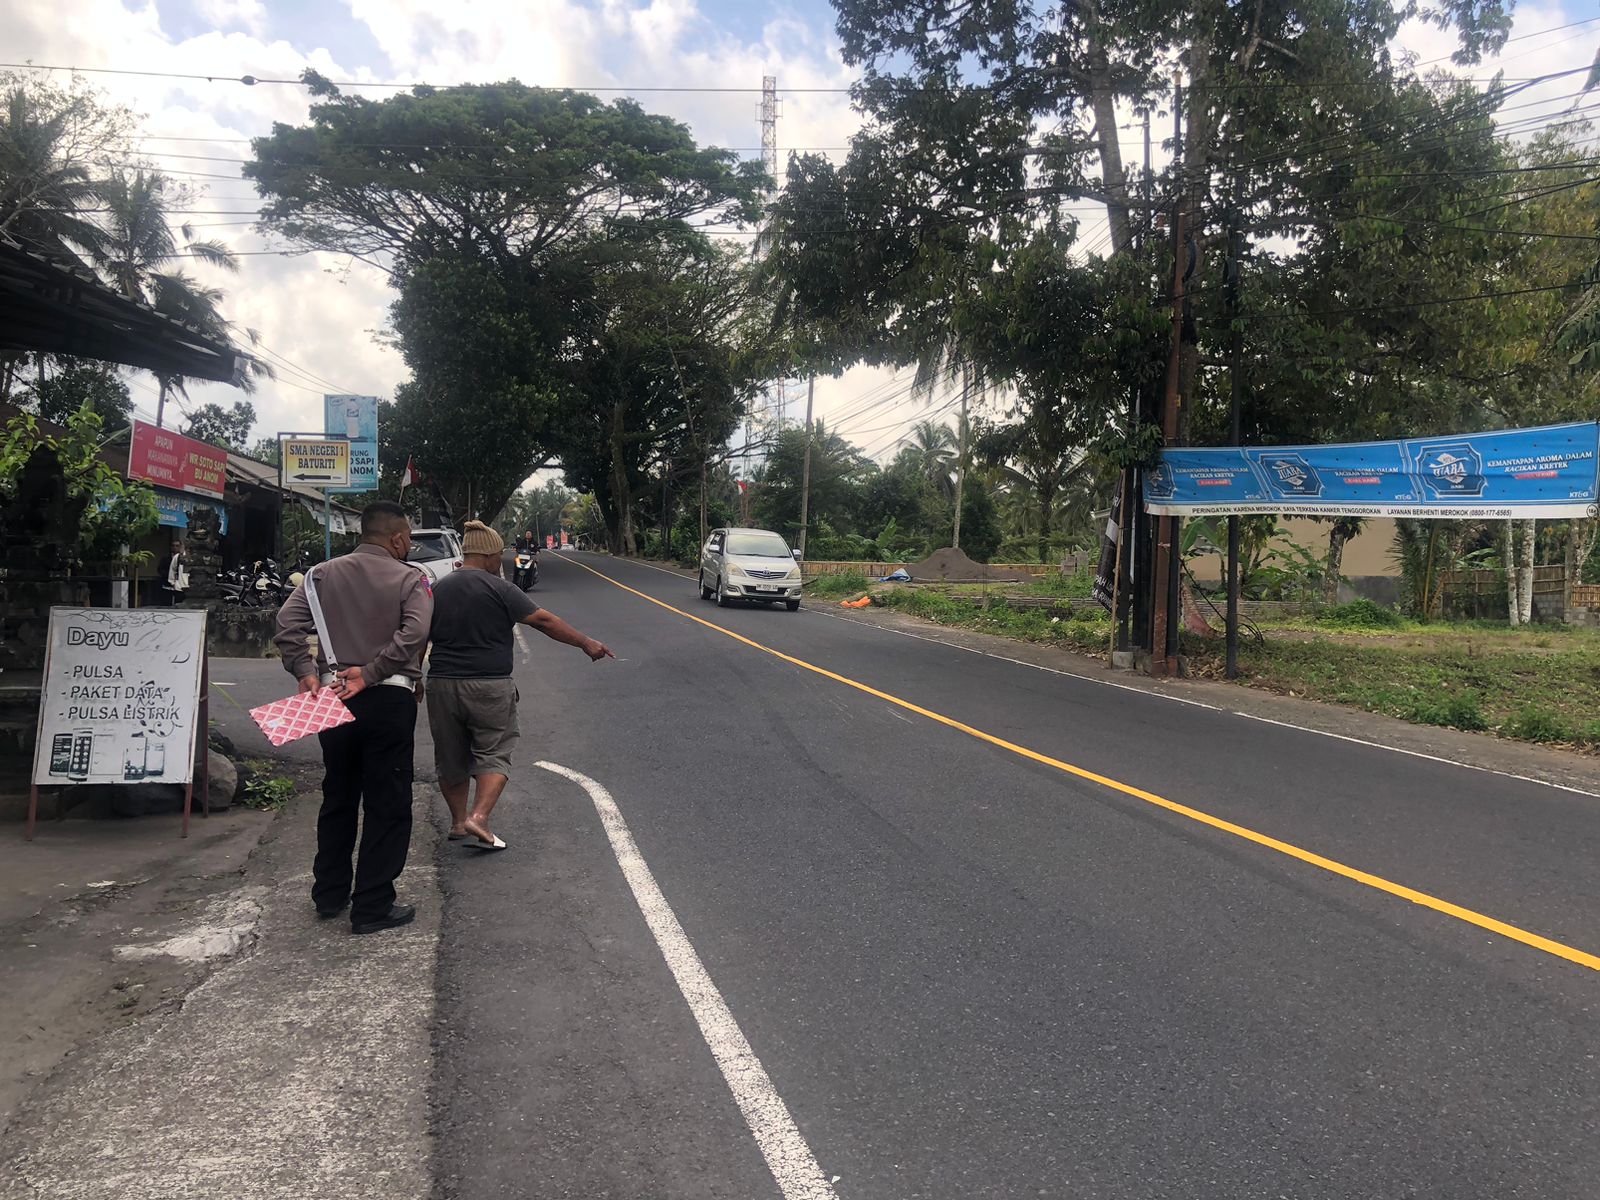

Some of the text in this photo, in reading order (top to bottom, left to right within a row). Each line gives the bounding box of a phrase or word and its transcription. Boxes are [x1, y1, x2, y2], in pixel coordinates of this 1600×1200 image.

[290, 445, 344, 456] SMA NEGERI 1
[298, 458, 336, 469] BATURITI
[1487, 451, 1593, 467] KEMANTAPAN AROMA DALAM
[1504, 461, 1568, 472] RACIKAN KRETEK
[67, 627, 129, 650] Dayu
[72, 665, 124, 678] PULSA
[70, 686, 163, 699] PAKET DATA
[68, 707, 180, 720] PULSA LISTRIK
